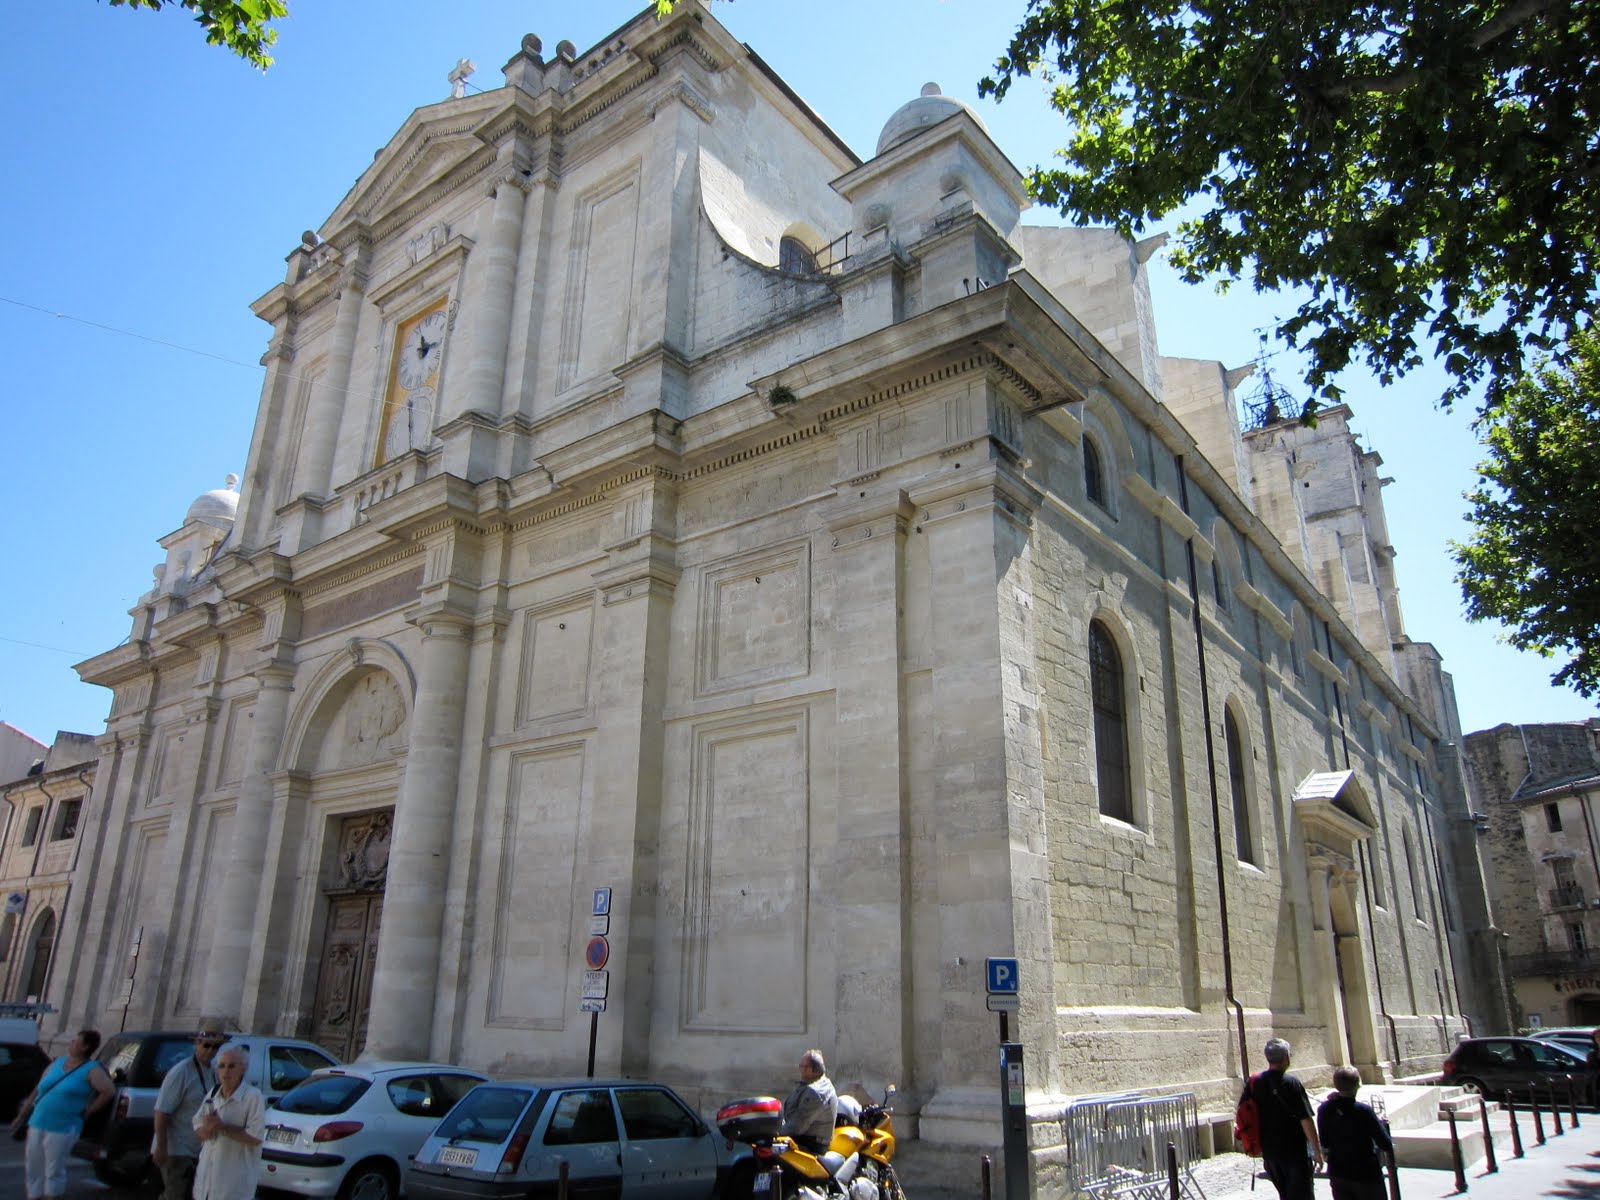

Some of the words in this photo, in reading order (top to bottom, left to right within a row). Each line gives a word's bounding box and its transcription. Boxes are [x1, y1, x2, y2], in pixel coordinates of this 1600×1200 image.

[597, 894, 604, 909] P
[996, 965, 1010, 986] P
[1000, 1048, 1006, 1066] P
